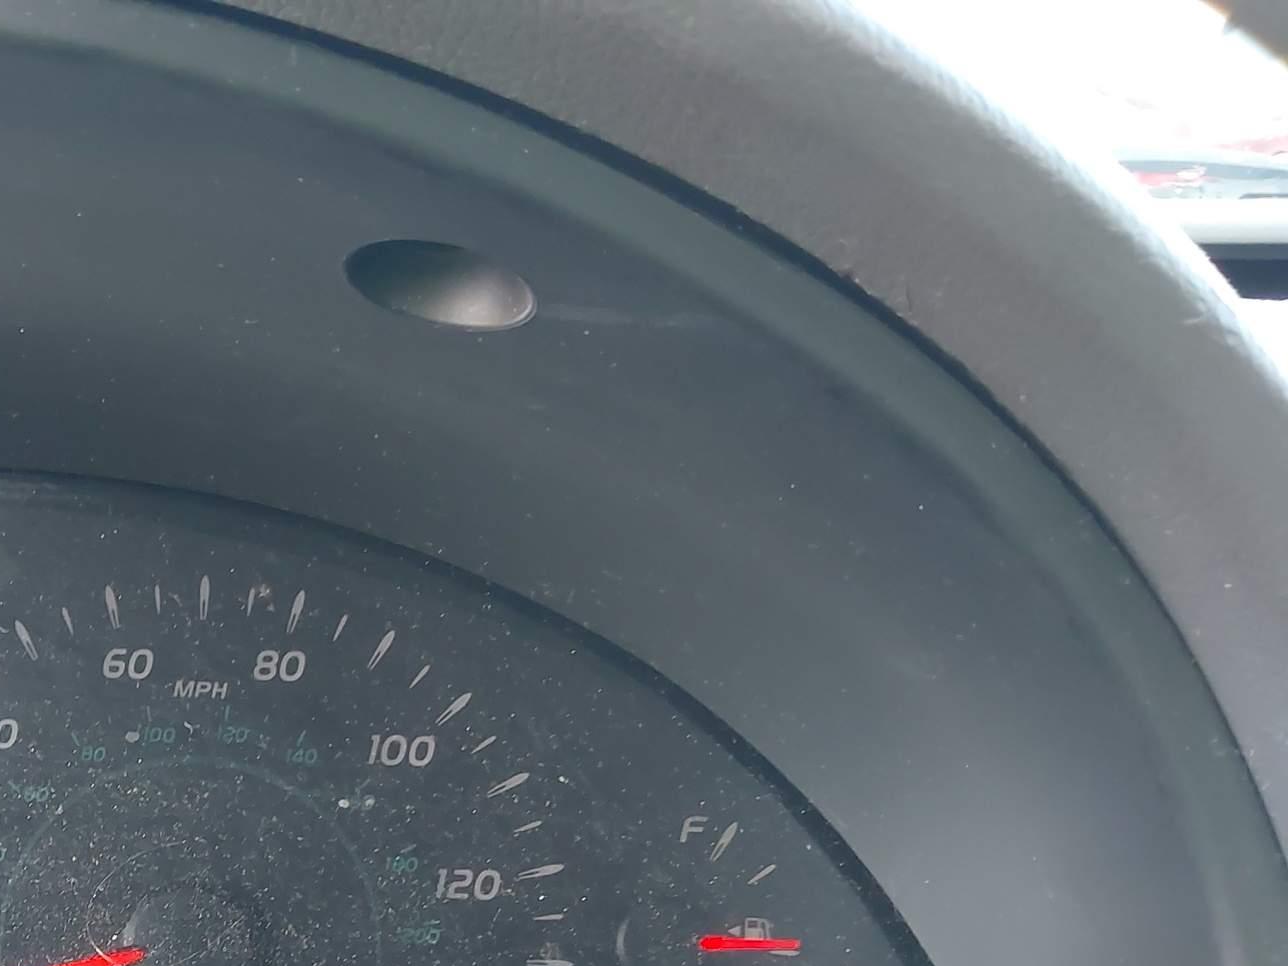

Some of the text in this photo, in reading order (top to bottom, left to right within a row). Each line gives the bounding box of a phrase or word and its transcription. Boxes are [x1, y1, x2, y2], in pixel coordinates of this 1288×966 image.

[103, 649, 154, 679] 60
[253, 651, 306, 681] 80
[173, 679, 228, 700] MPH
[367, 734, 435, 766] 100
[680, 816, 708, 843] F
[436, 868, 501, 901] 120
